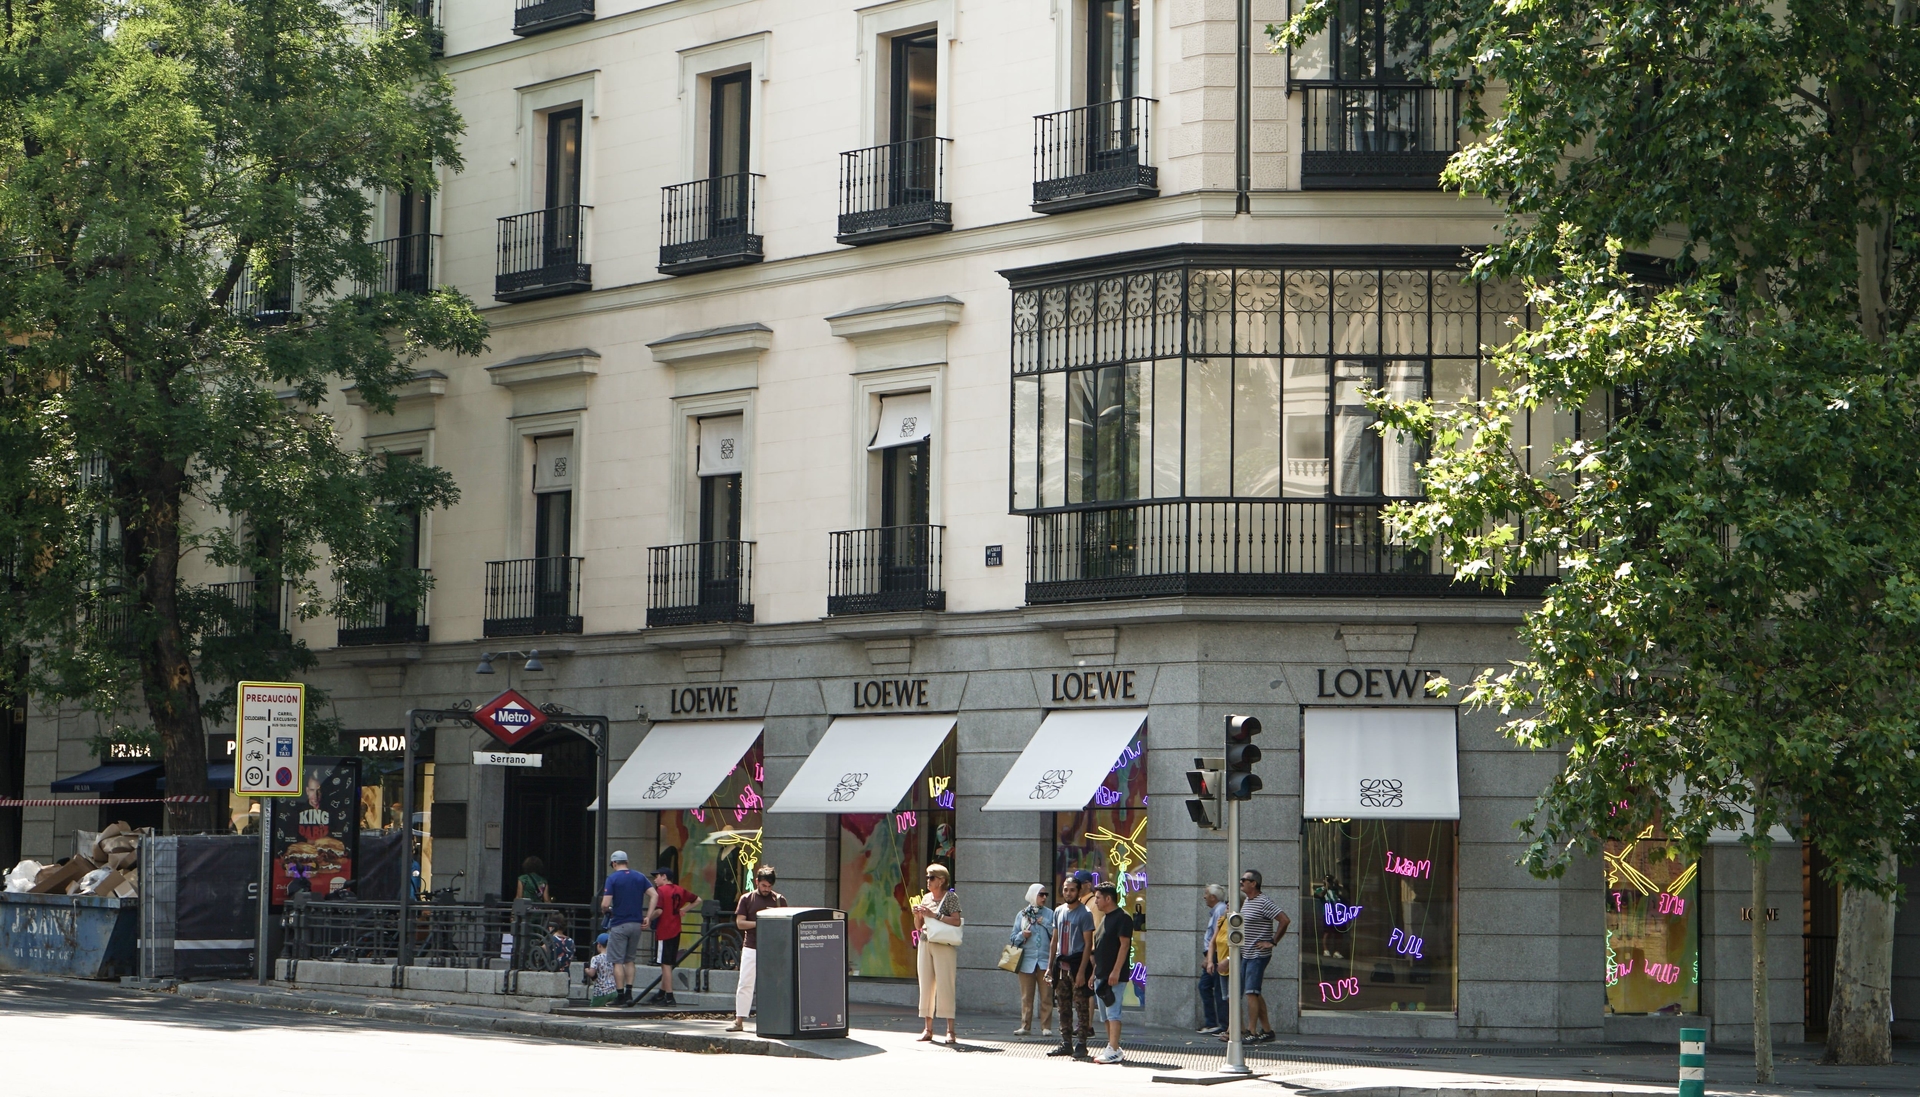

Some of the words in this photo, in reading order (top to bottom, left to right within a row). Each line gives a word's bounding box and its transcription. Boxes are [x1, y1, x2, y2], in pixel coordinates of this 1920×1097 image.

[1051, 670, 1136, 701] LOEWE
[1317, 668, 1443, 699] LOEWE
[246, 692, 298, 704] PRECAUCIÓN
[671, 686, 738, 714] LOEWE
[853, 679, 930, 708] LOEWE
[498, 710, 529, 723] Metro
[359, 735, 406, 752] PRADA
[490, 754, 526, 764] Serrano
[249, 772, 260, 780] 30
[74, 784, 90, 792] PRADA
[299, 808, 330, 825] KING
[1741, 907, 1780, 921] LOWE
